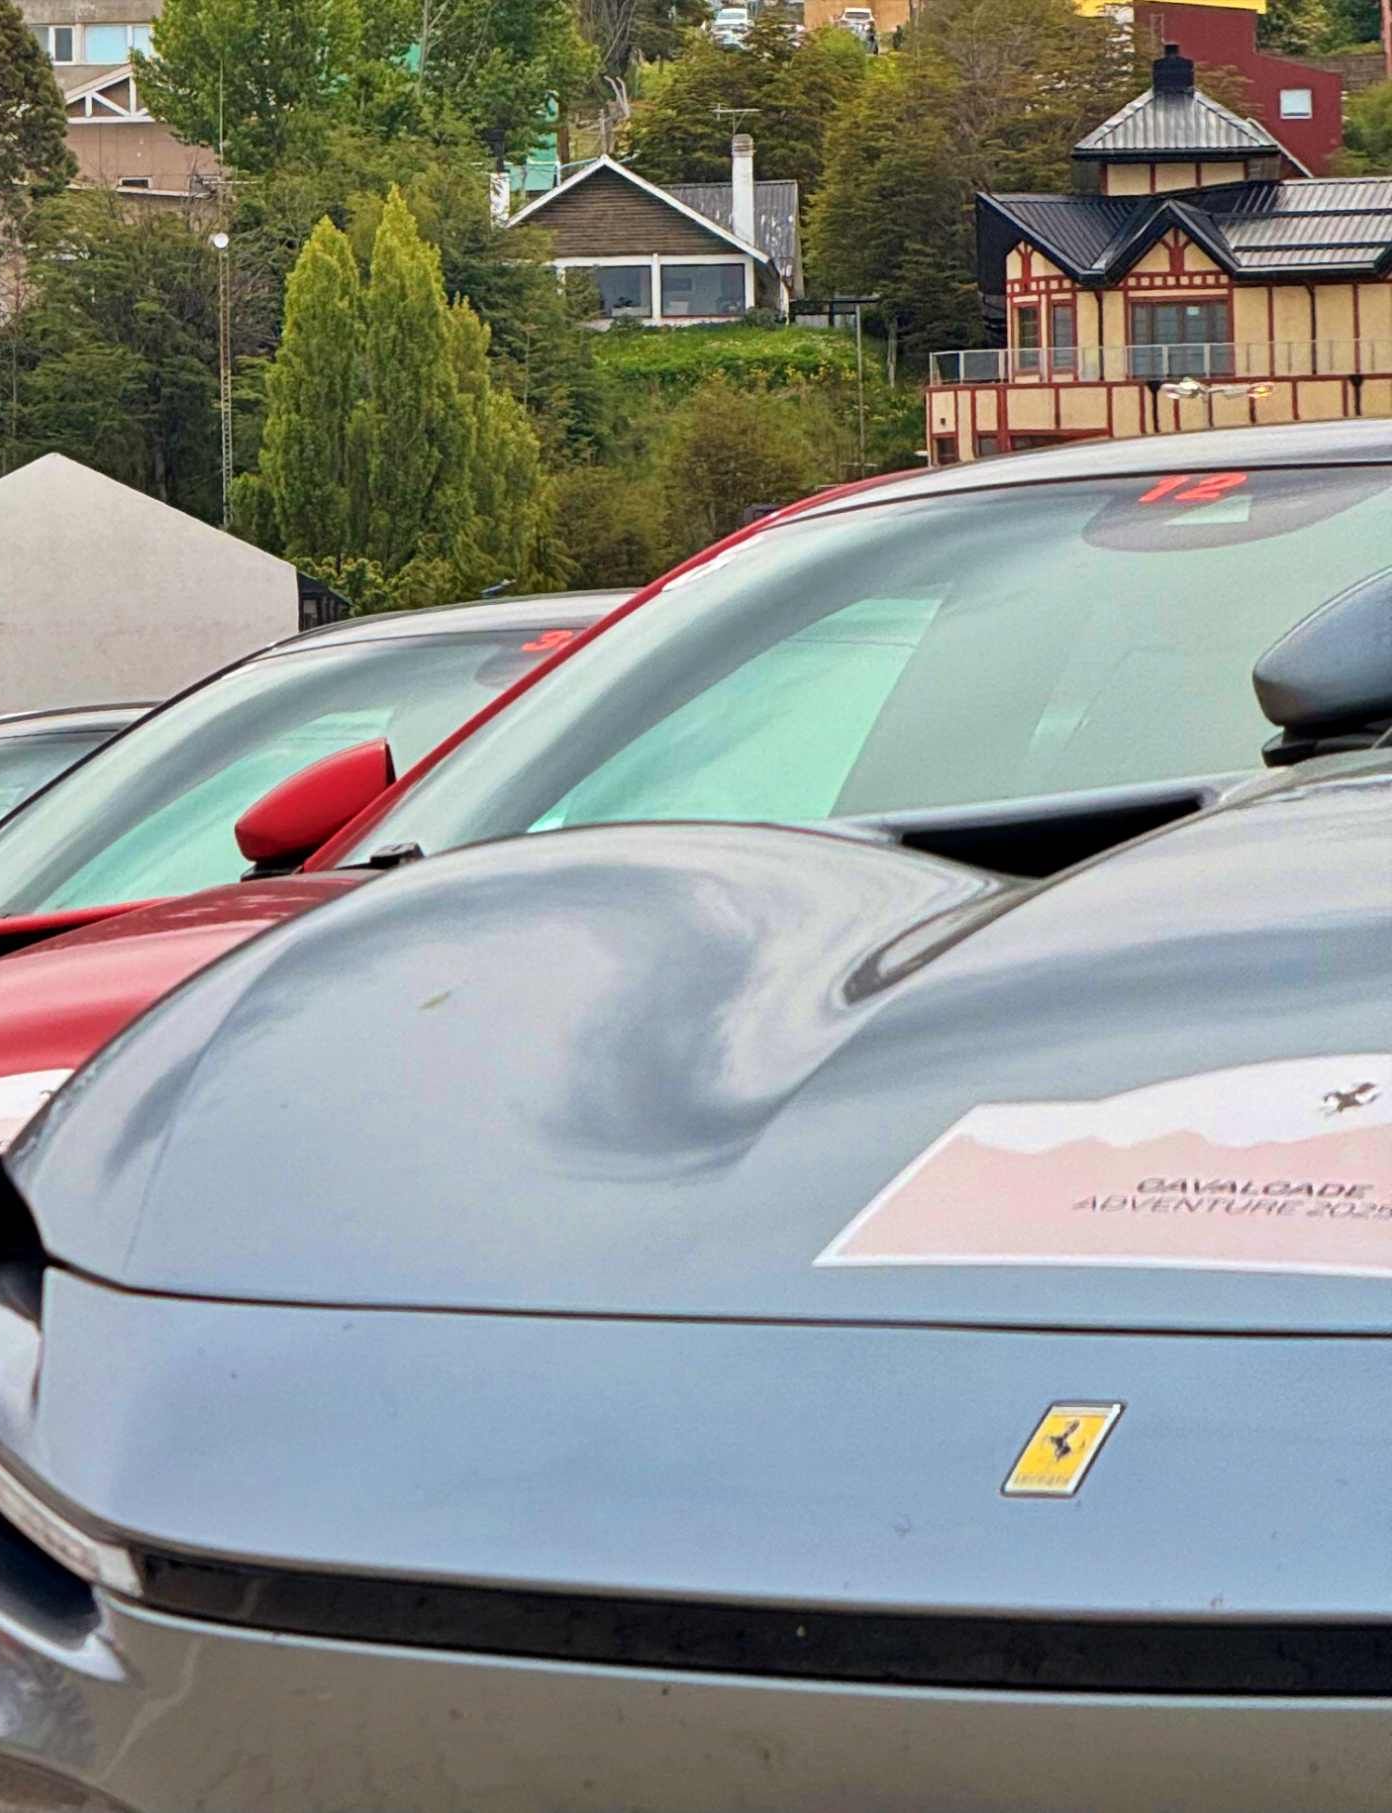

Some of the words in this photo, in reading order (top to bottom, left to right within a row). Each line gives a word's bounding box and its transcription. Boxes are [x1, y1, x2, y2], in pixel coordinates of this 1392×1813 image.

[1138, 474, 1247, 501] 12
[1137, 1177, 1374, 1198] CAVALCADE
[1072, 1195, 1303, 1215] ADVENTURE
